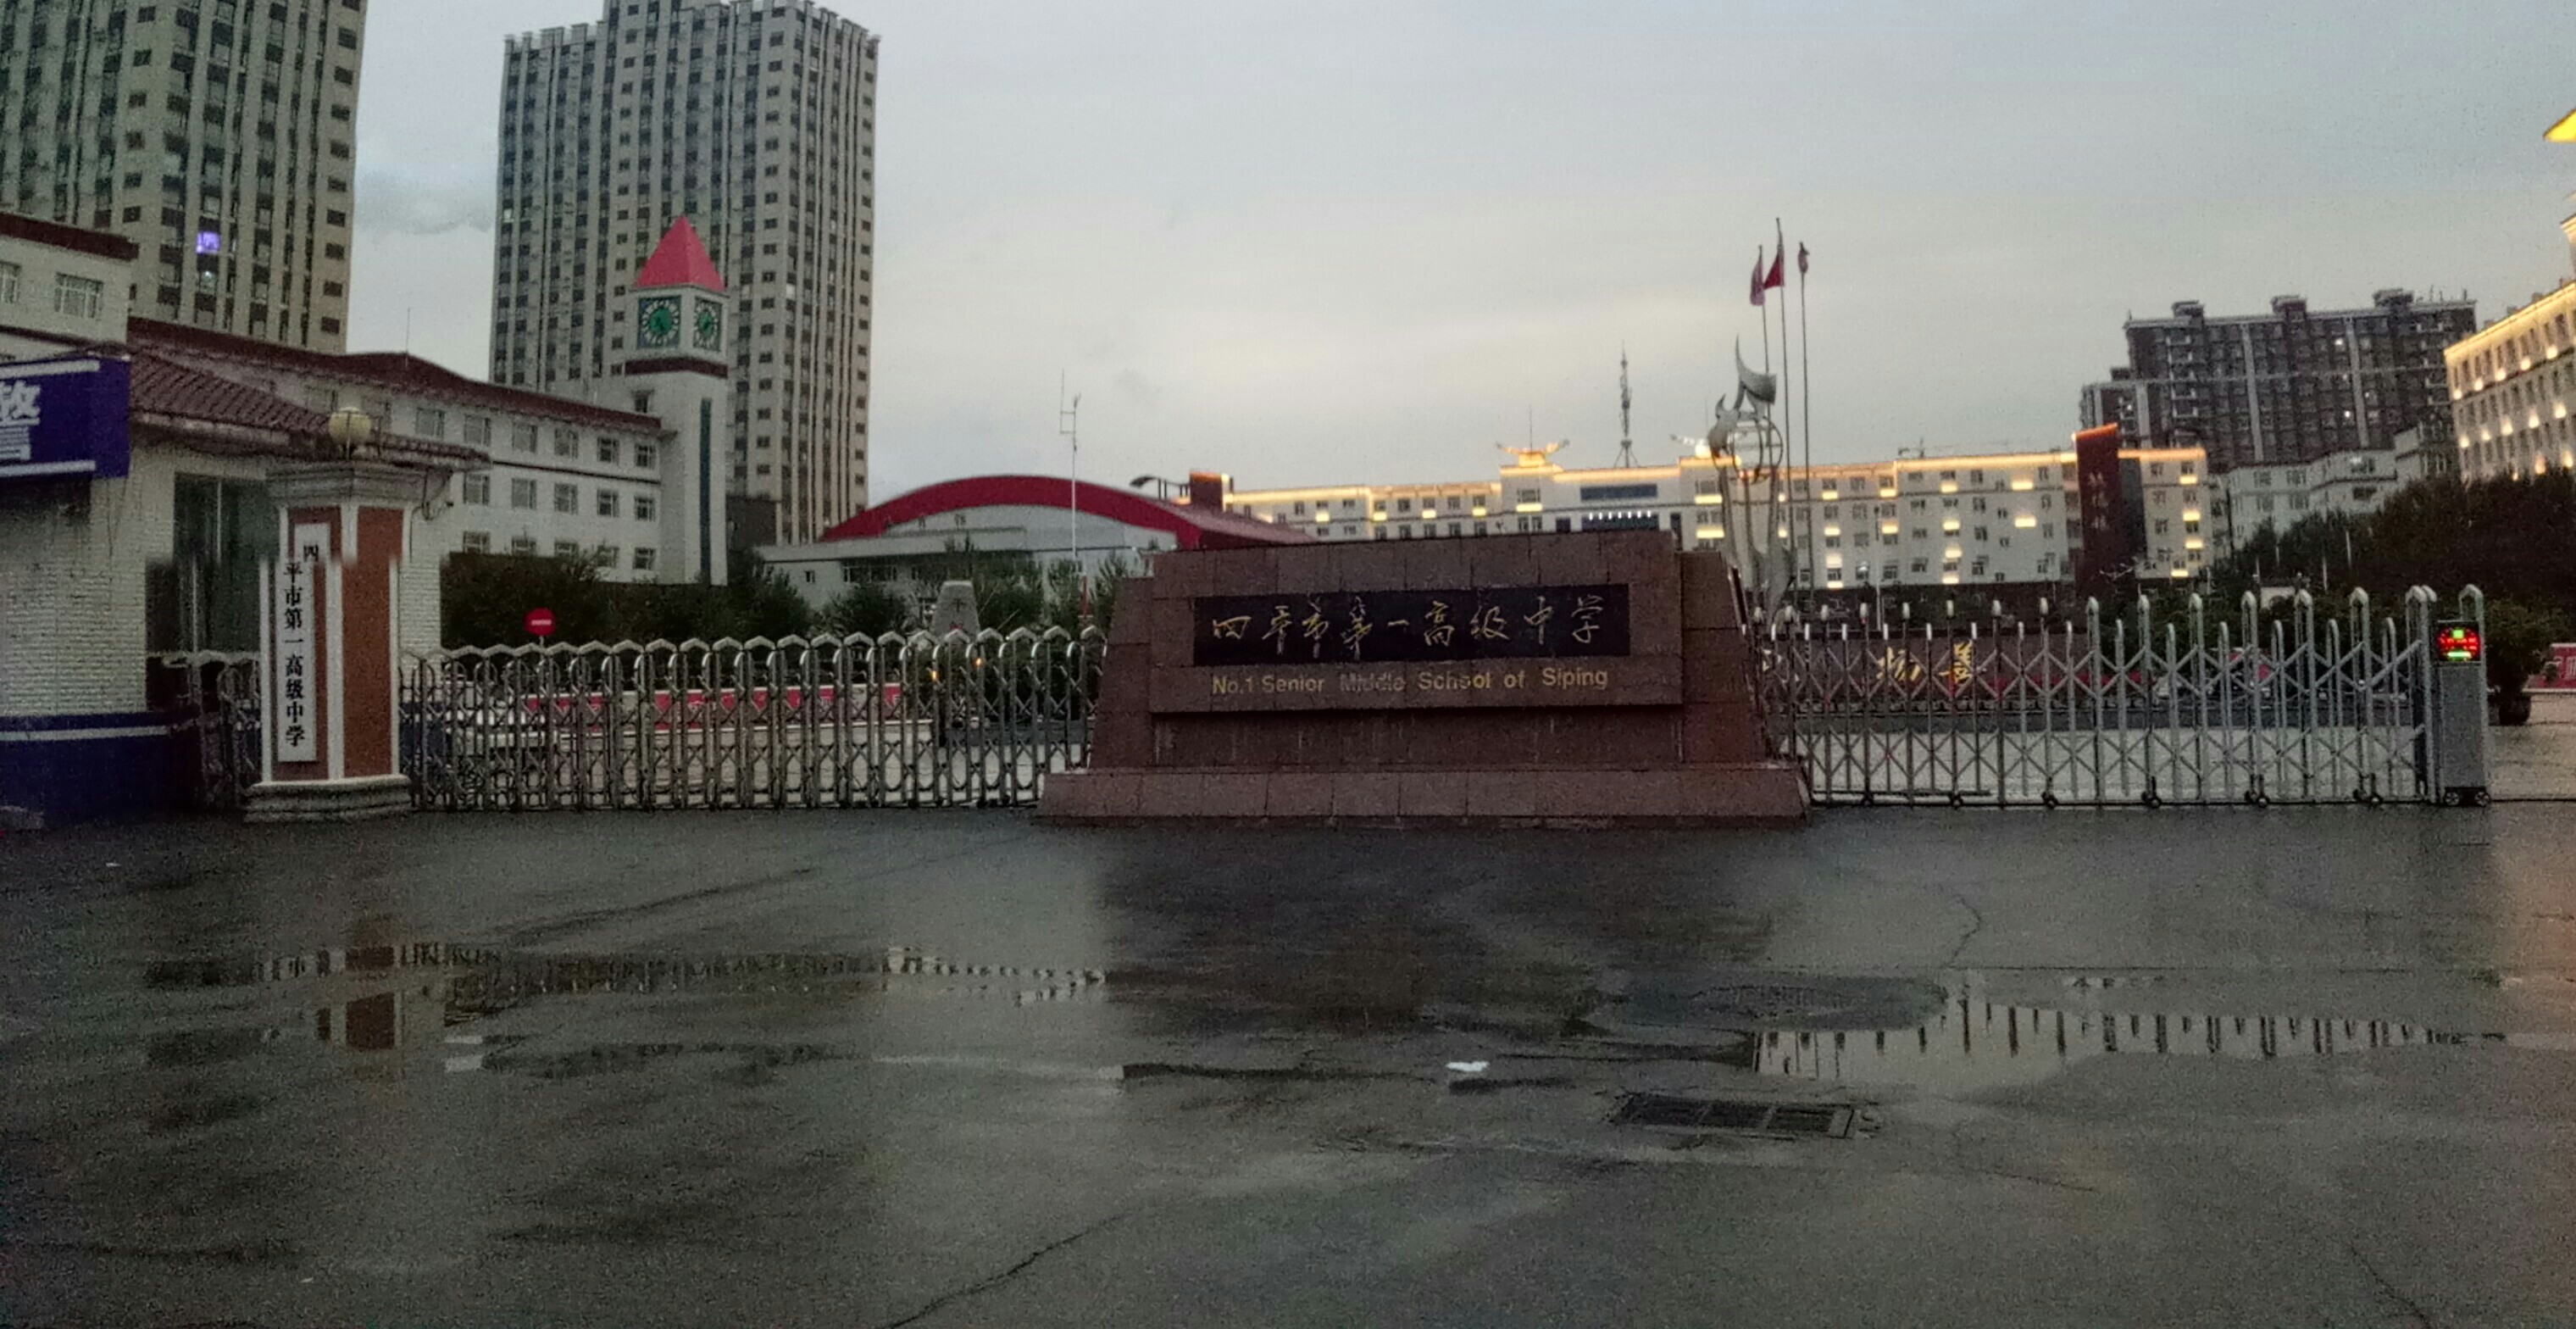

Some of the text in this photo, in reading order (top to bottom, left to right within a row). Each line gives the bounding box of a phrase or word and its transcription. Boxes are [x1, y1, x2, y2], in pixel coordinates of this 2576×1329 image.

[283, 543, 319, 748] 四平市第一高级中学
[1213, 593, 1604, 661] 四平市第一高级中学
[1212, 676, 1254, 695] No.1
[1262, 675, 1325, 692] Senior
[1418, 670, 1491, 691] School
[1503, 670, 1525, 688] of
[1541, 667, 1608, 691] Siping
